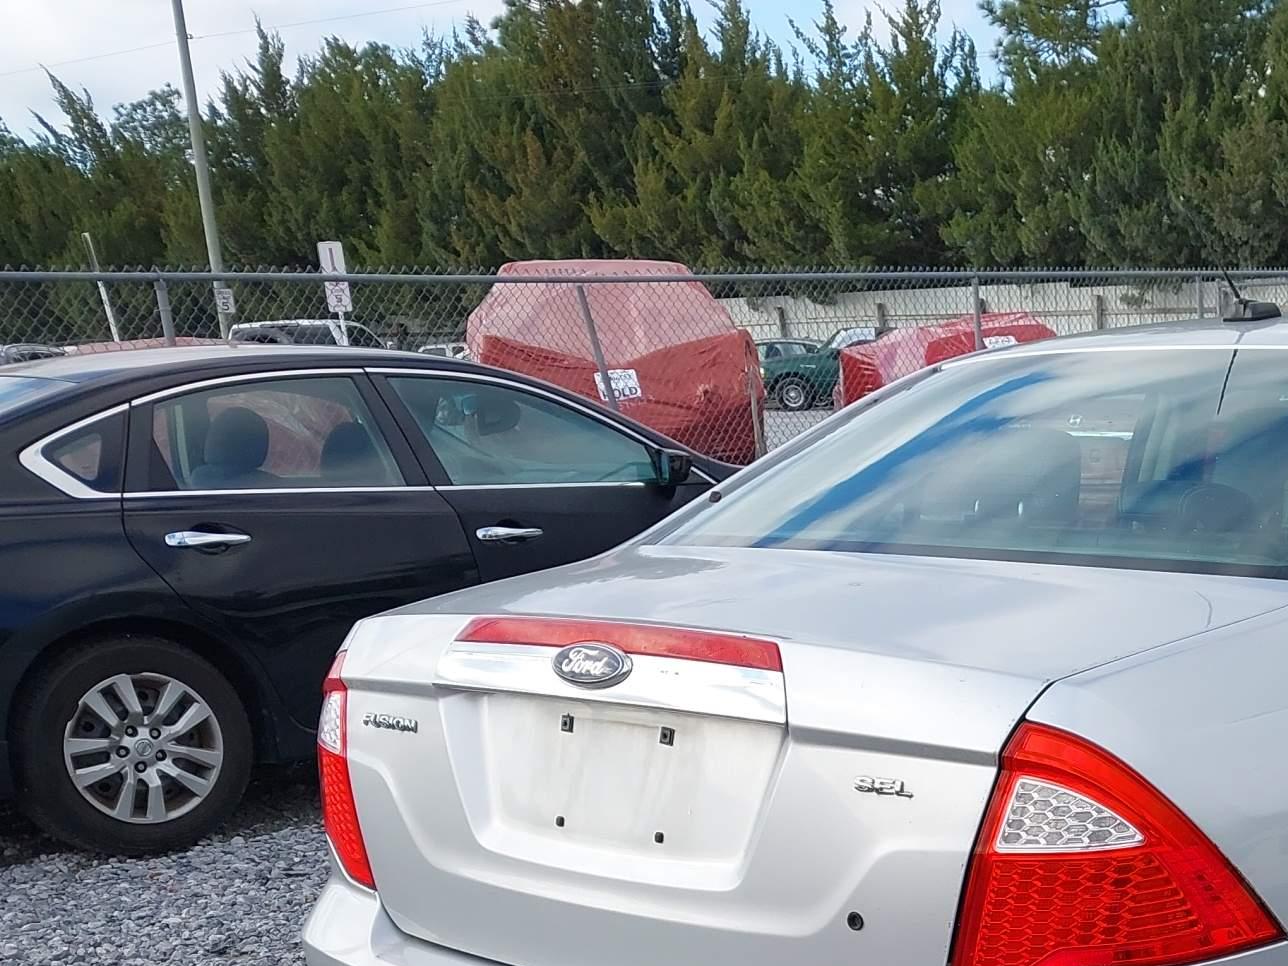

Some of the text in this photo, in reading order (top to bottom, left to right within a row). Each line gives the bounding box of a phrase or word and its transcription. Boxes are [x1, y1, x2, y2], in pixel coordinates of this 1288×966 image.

[221, 301, 230, 311] 5
[561, 647, 605, 676] Ford
[362, 712, 419, 734] FUSION
[853, 775, 914, 799] SEL
